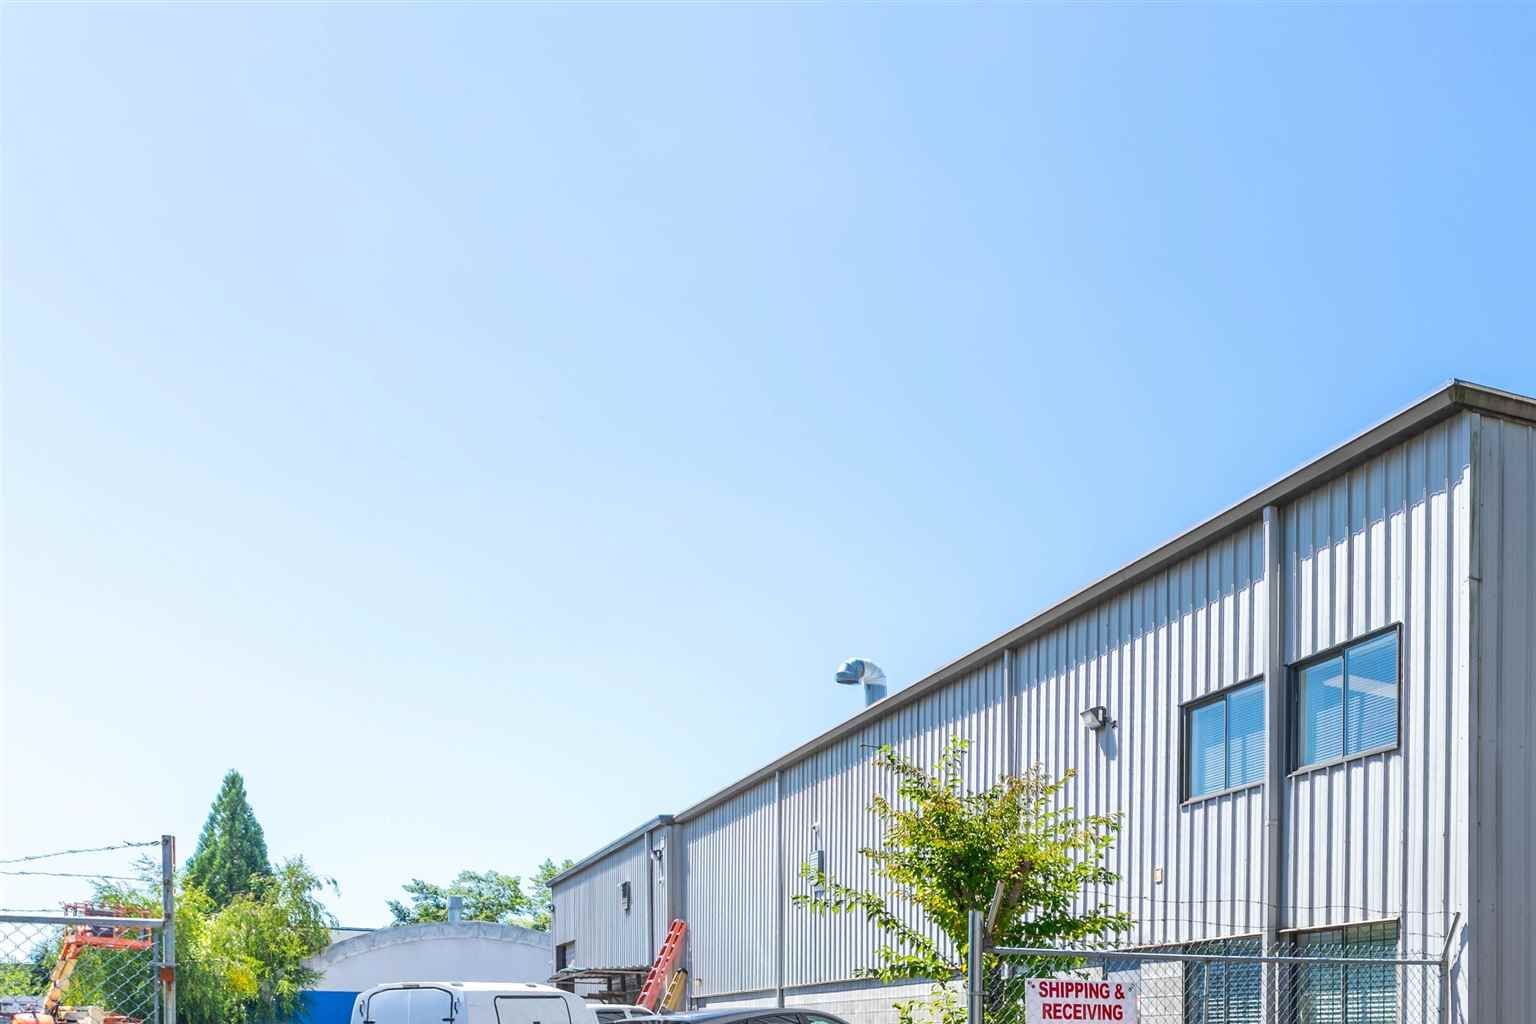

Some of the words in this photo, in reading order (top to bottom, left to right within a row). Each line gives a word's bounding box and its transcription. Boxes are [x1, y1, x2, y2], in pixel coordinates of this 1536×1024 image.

[1038, 981, 1110, 999] SHIPPING
[1114, 983, 1126, 1000] &
[1042, 1003, 1124, 1021] RECEIVING
